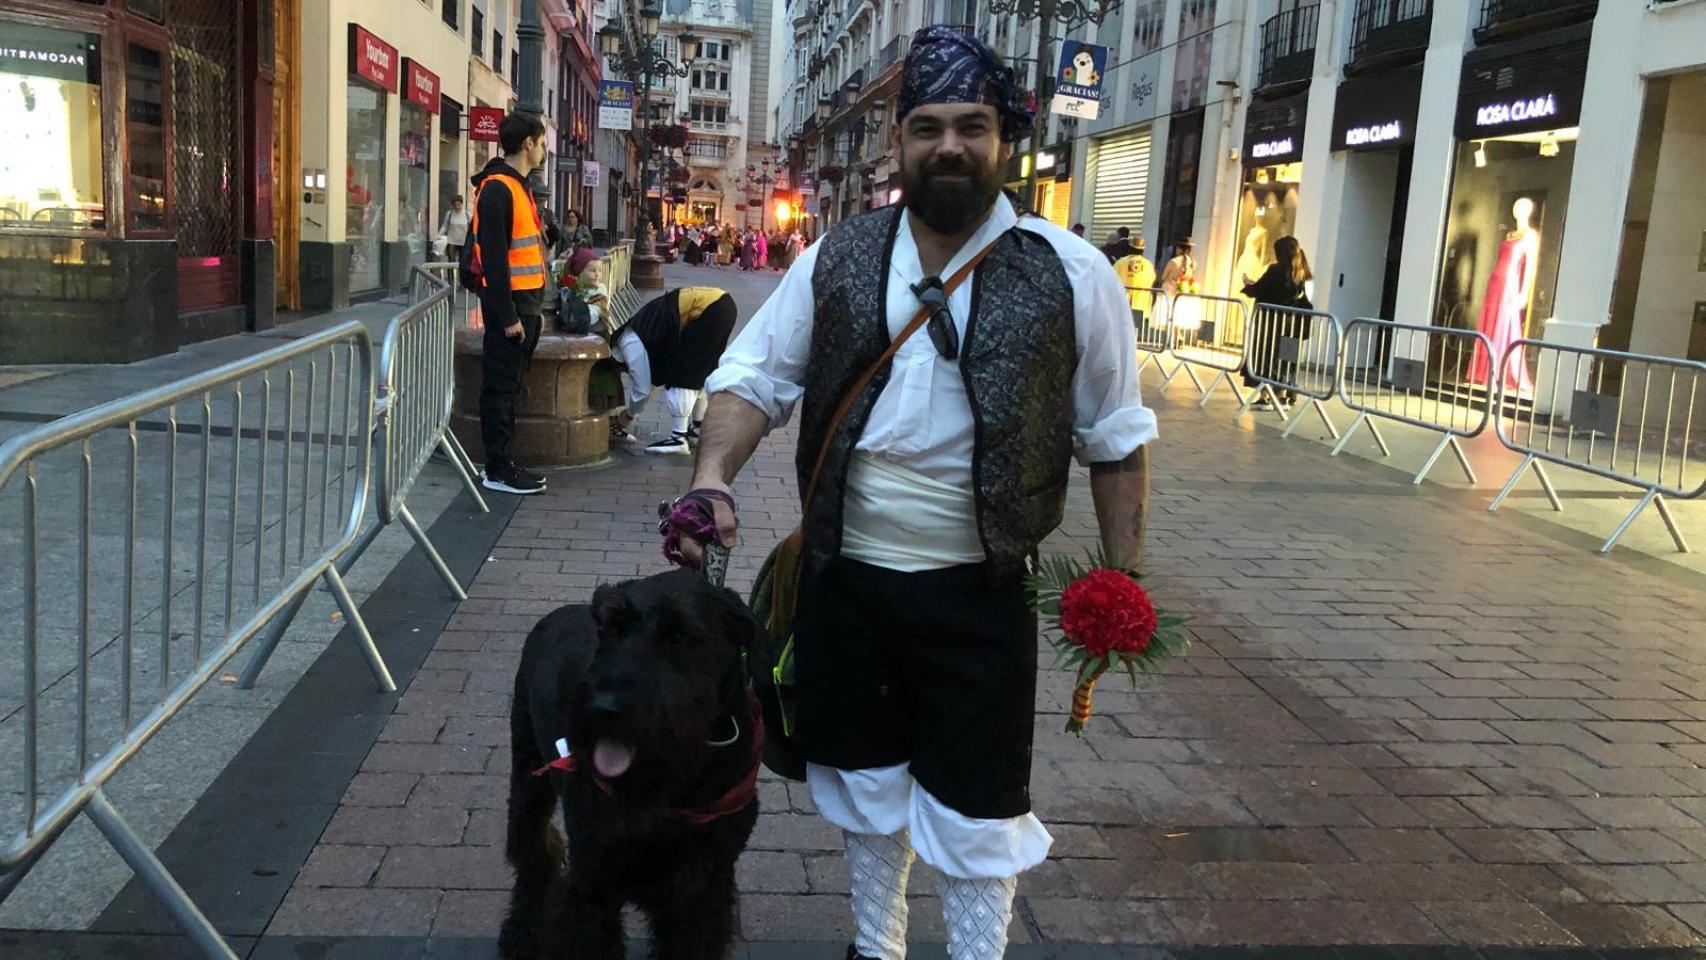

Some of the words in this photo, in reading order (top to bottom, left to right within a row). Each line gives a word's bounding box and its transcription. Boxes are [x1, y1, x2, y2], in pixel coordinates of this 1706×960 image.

[1132, 82, 1153, 107] Regus
[1476, 104, 1510, 126] ROSA
[1511, 93, 1555, 121] CLARÁ
[1346, 127, 1369, 145] ROSA
